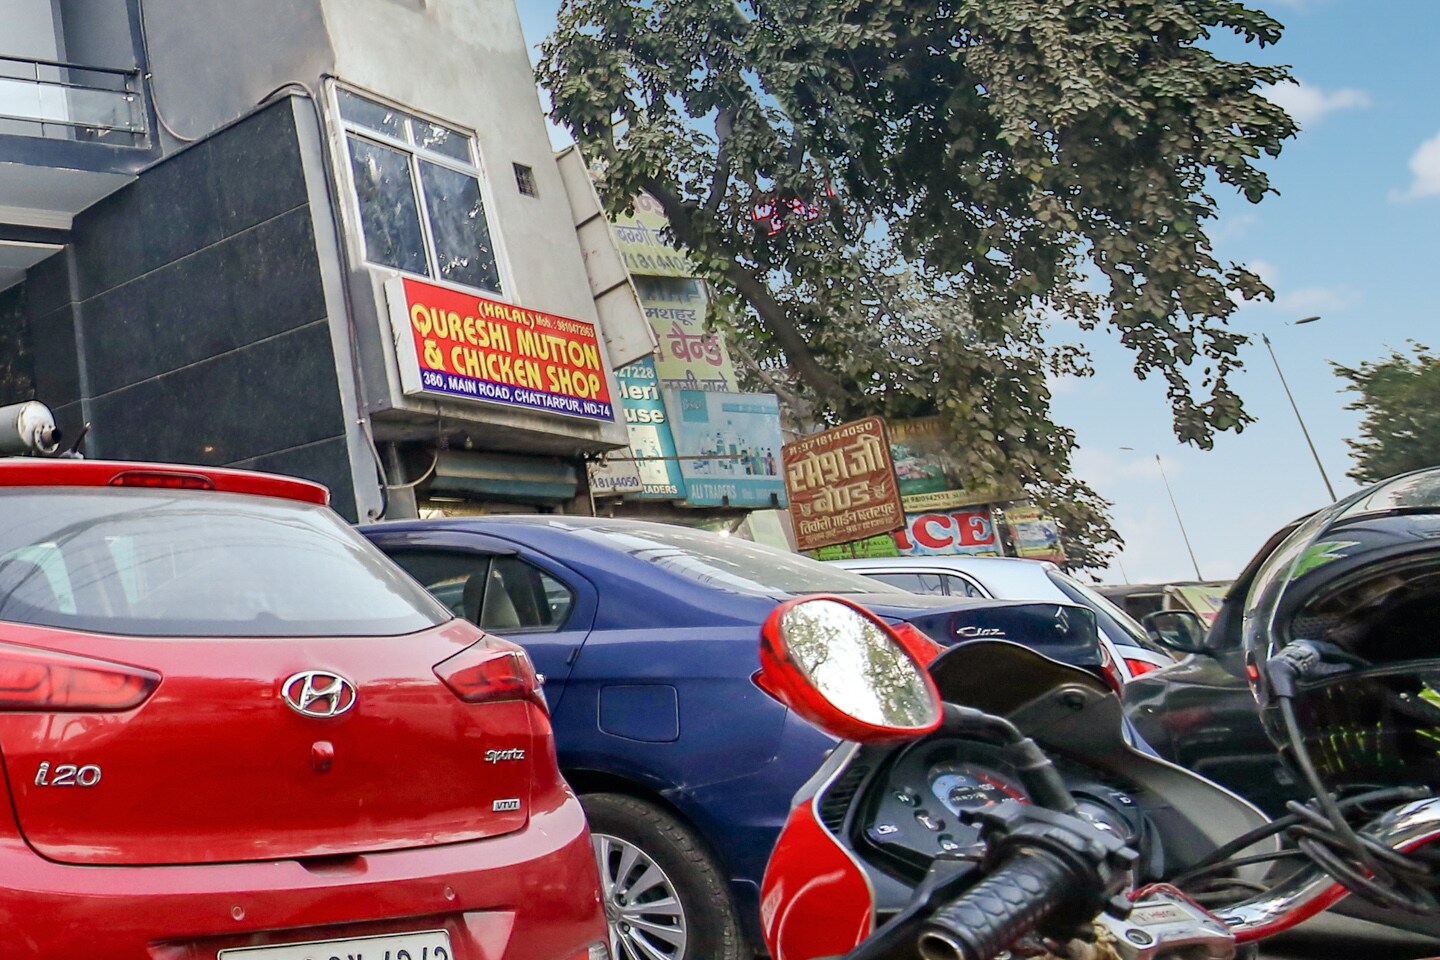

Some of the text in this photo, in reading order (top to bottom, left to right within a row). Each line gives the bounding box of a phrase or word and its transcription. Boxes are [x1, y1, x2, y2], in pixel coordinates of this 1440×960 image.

[478, 300, 535, 329] (HALAL)
[411, 304, 512, 353] QURESHI
[516, 328, 601, 372] MUTTON
[424, 339, 601, 400] & CHICKEN SHOP
[423, 372, 610, 417] 380, MAIN ROAD, CHATTARPUR, ND-74
[619, 381, 659, 401] leri
[484, 748, 525, 765] Sportz
[35, 761, 102, 787] i20
[496, 800, 518, 809] VTVT
